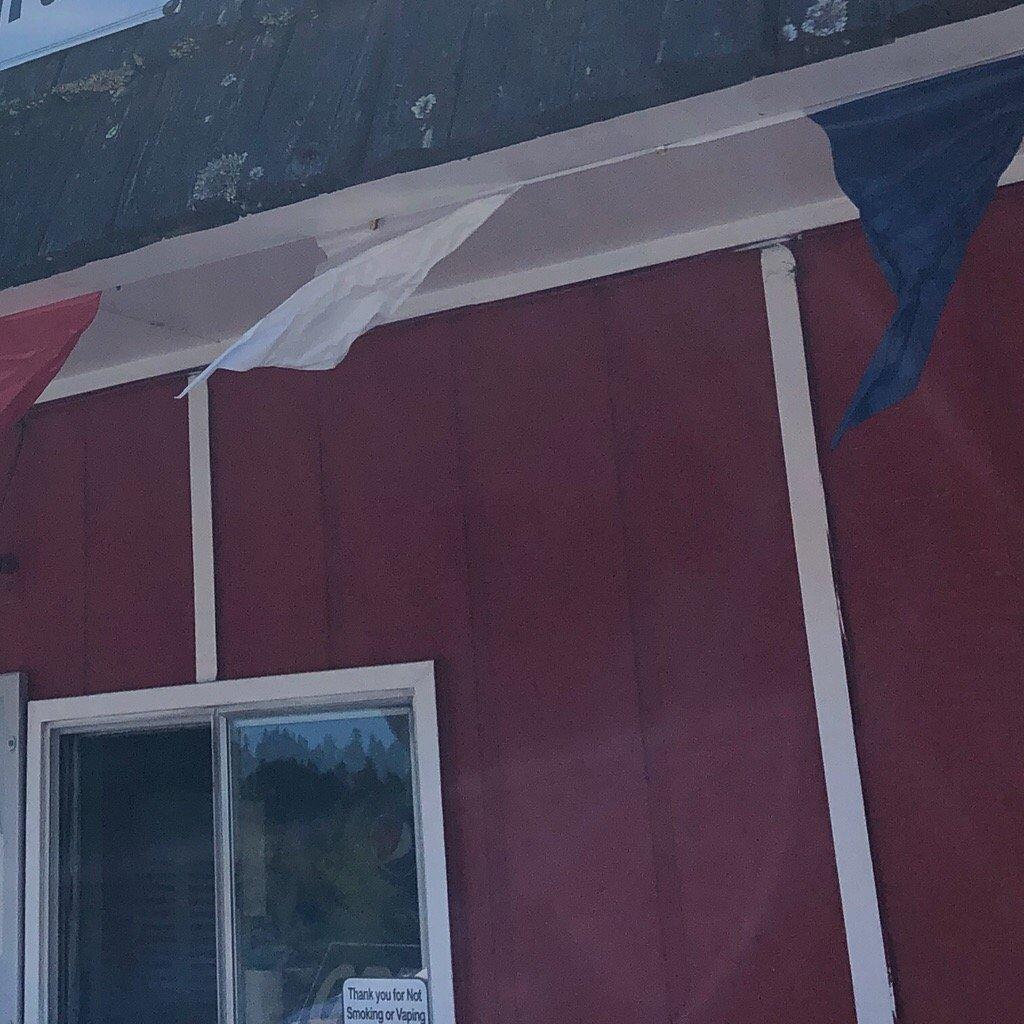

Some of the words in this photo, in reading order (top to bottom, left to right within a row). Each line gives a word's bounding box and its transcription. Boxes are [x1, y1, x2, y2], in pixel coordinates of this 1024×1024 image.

[347, 987, 374, 1001] Thank
[375, 990, 392, 1004] you
[392, 988, 406, 1002] for
[406, 988, 423, 1002] Not
[346, 1006, 384, 1024] Smoking
[385, 1010, 396, 1021] or
[396, 1007, 426, 1024] Vaping
